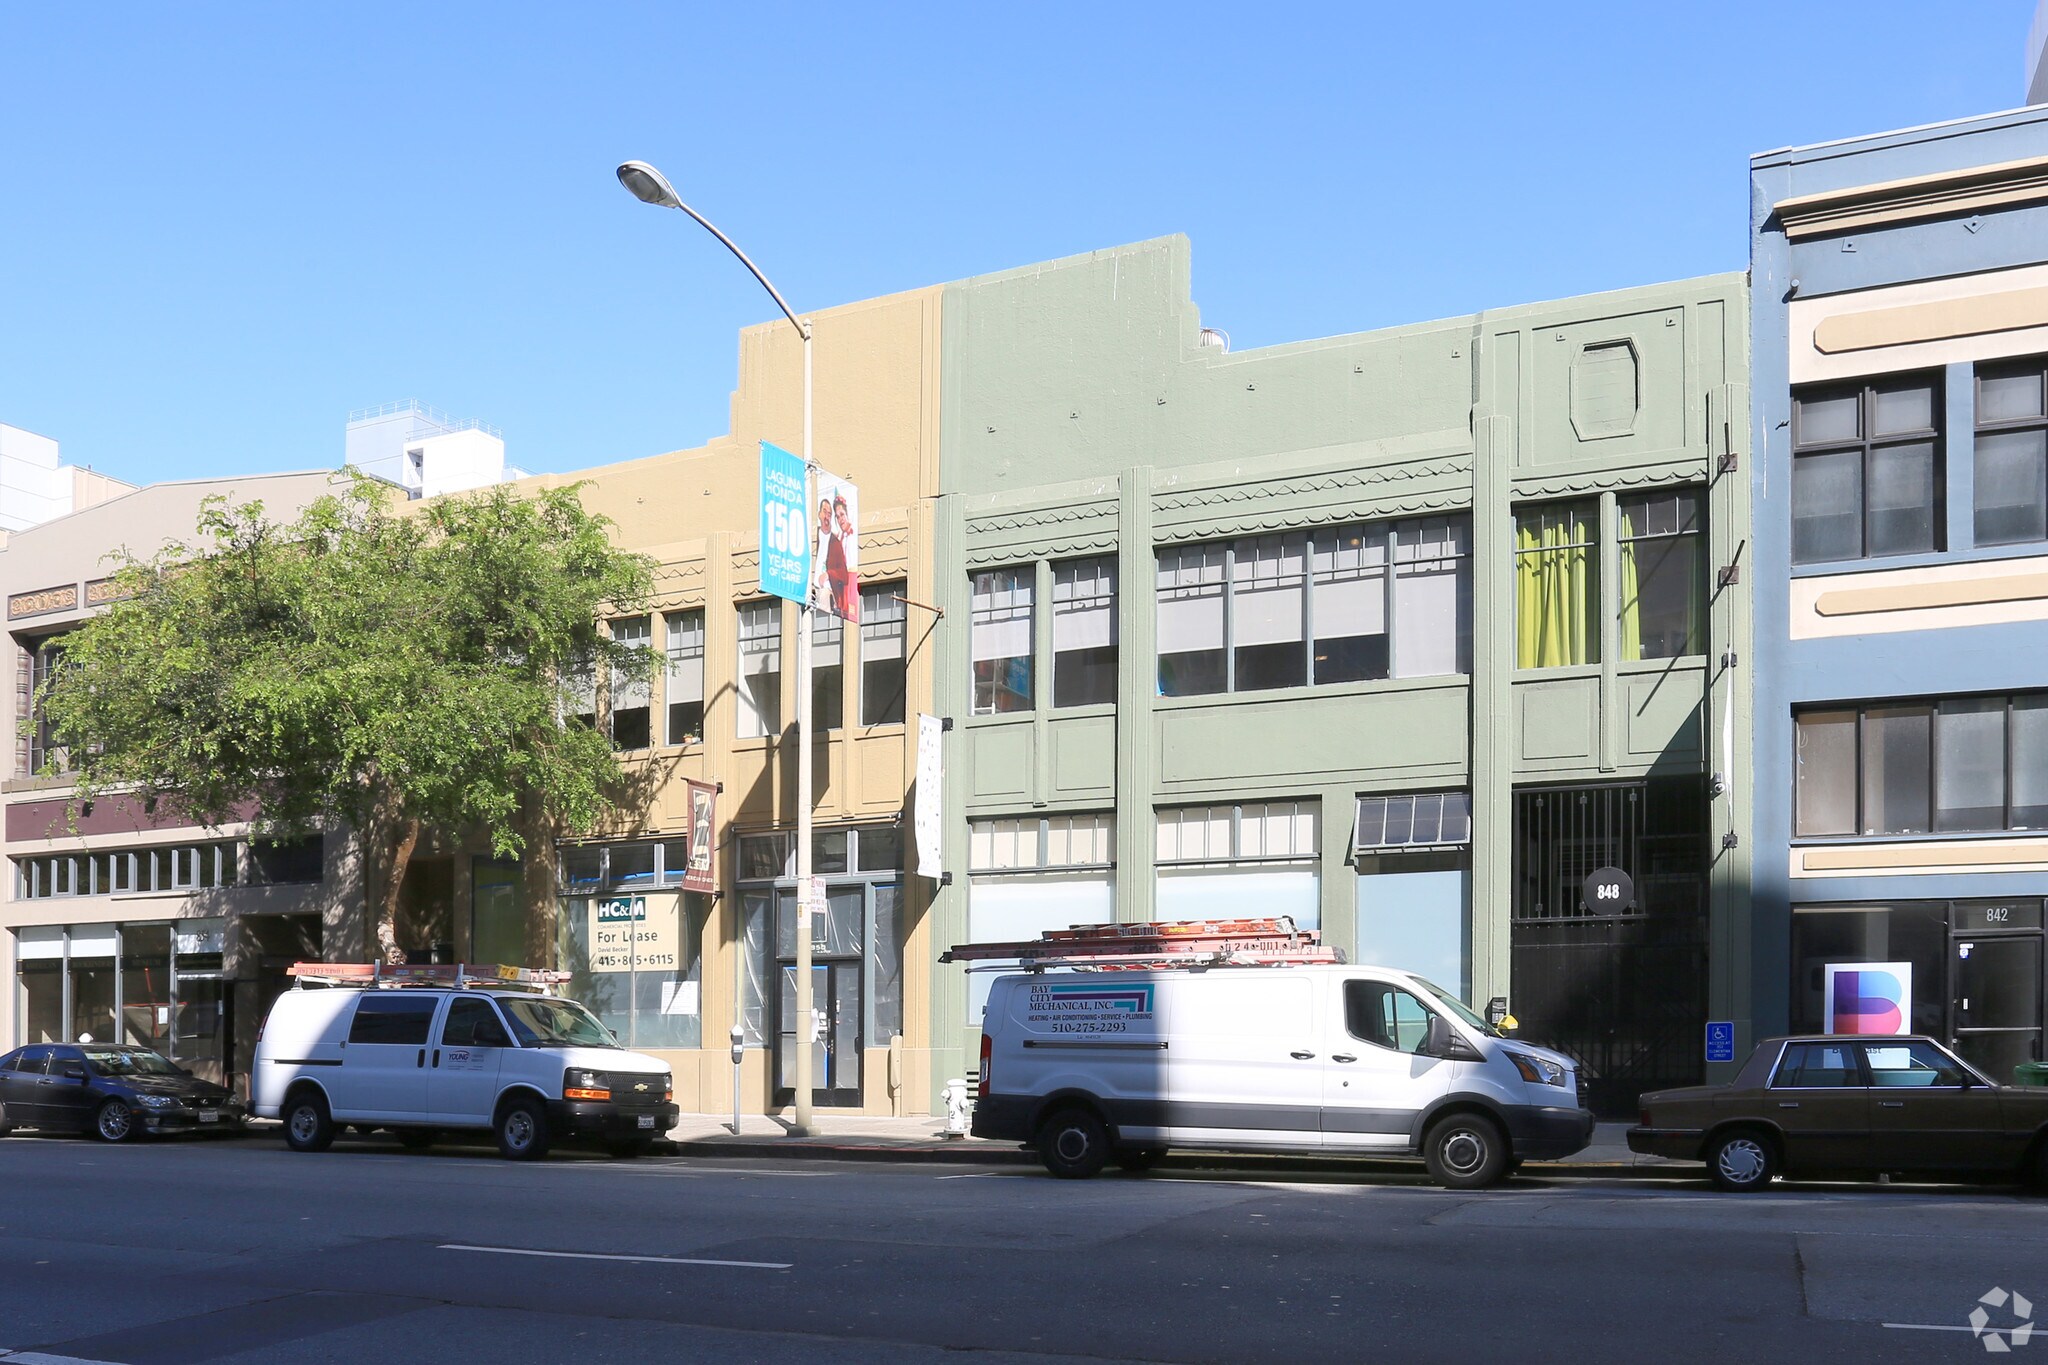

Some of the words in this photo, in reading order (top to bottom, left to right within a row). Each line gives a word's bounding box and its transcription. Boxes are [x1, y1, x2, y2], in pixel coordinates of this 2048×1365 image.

[766, 468, 802, 491] LAGUNA
[766, 482, 802, 504] HONDA
[764, 500, 805, 557] 150
[768, 553, 801, 573] YEARS
[769, 567, 779, 578] OF
[781, 570, 801, 584] CARE
[1597, 884, 1620, 900] 848
[598, 901, 644, 917] HC&M
[1986, 908, 2008, 922] 842
[597, 931, 616, 943] For
[1031, 985, 1050, 994] BAY
[1030, 993, 1052, 1002] CITY
[1029, 1001, 1092, 1011] MECHANICAL,
[1094, 1001, 1114, 1010] INC.
[1062, 1013, 1098, 1021] CONDITIONING
[1125, 1012, 1152, 1020] PLUMBING
[1051, 1022, 1126, 1033] 510-275-2293
[448, 1053, 469, 1061] YOUNG
